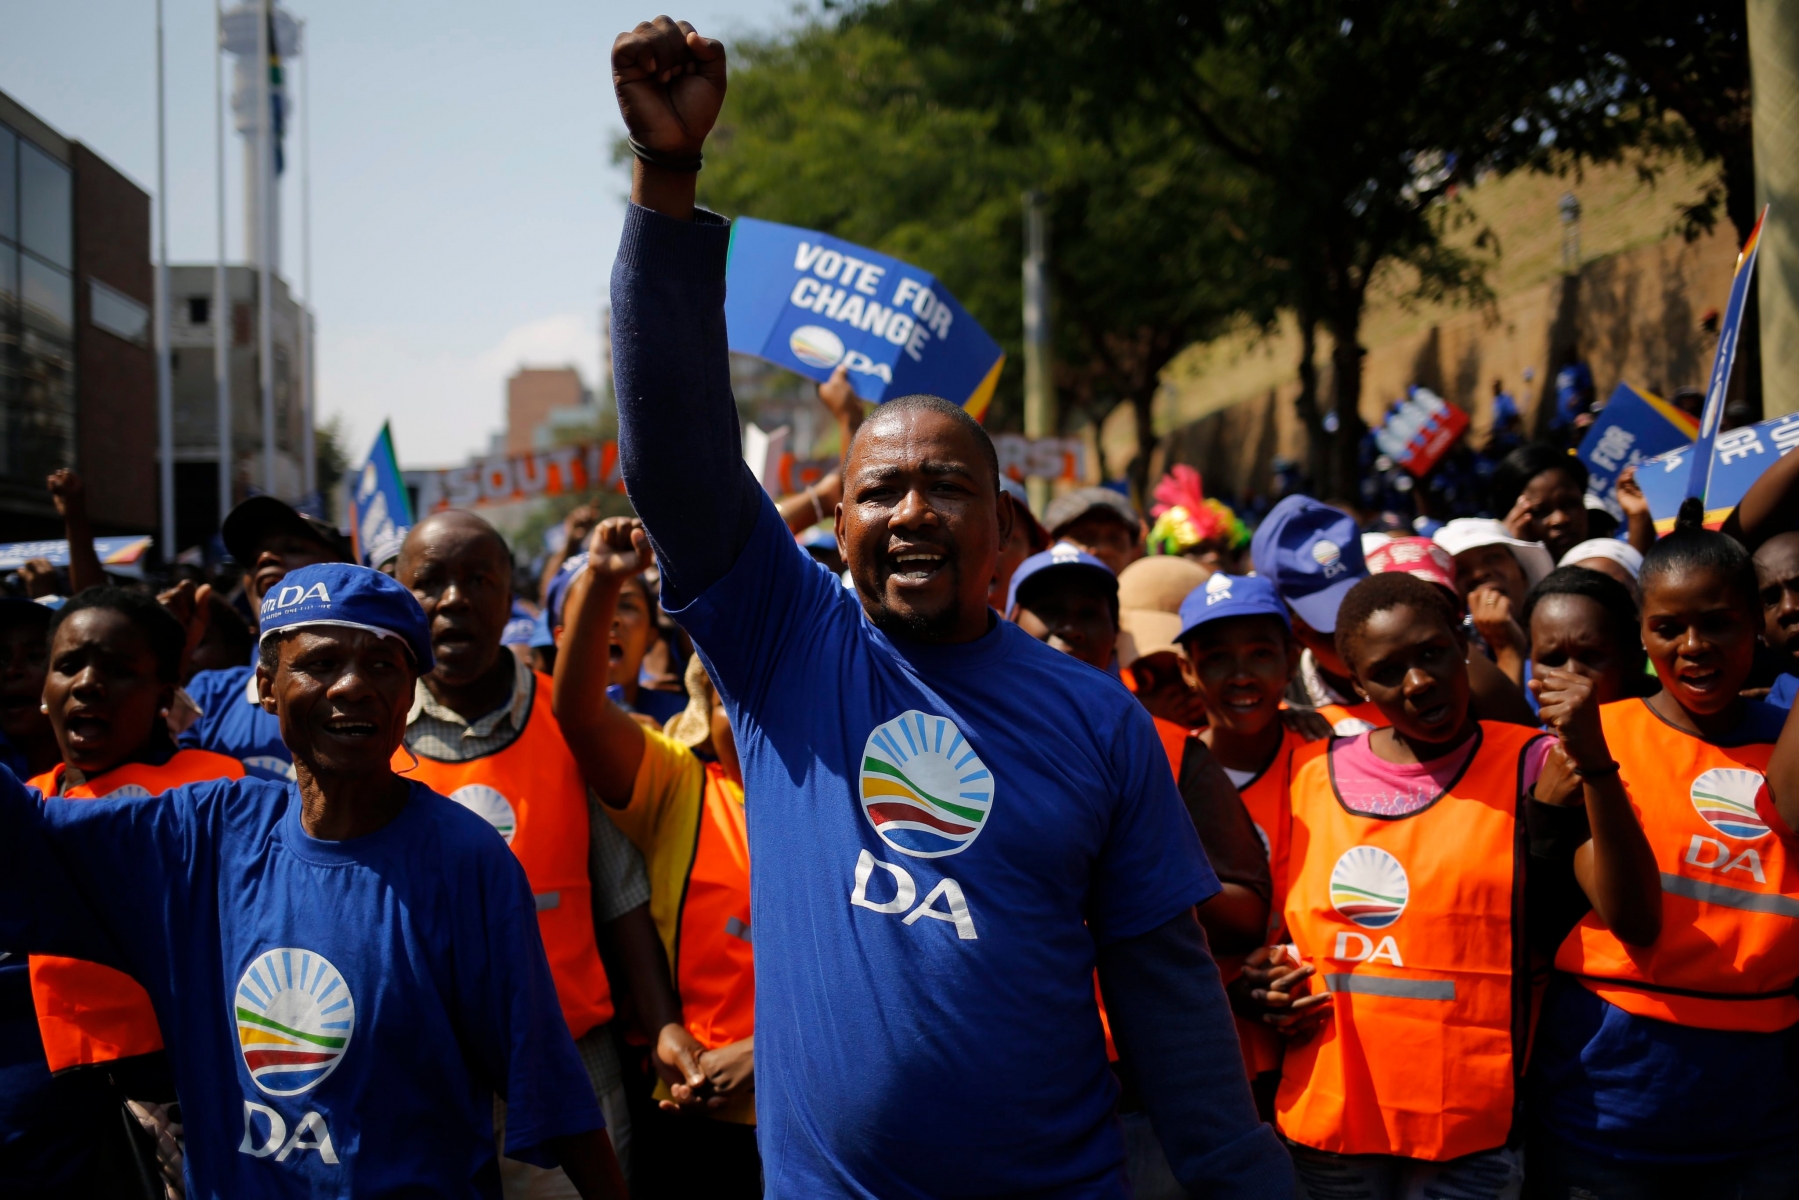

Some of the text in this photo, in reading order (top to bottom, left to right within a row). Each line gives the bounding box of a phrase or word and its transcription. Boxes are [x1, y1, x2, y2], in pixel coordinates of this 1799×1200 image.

[793, 241, 954, 341] VOTE FOR
[790, 277, 932, 362] CHANGE
[843, 349, 893, 384] DA
[1590, 424, 1636, 472] FOR
[277, 582, 331, 609] DA
[1684, 833, 1767, 884] DA
[850, 848, 979, 940] DA
[1333, 931, 1404, 968] DA
[237, 1100, 340, 1164] DA
